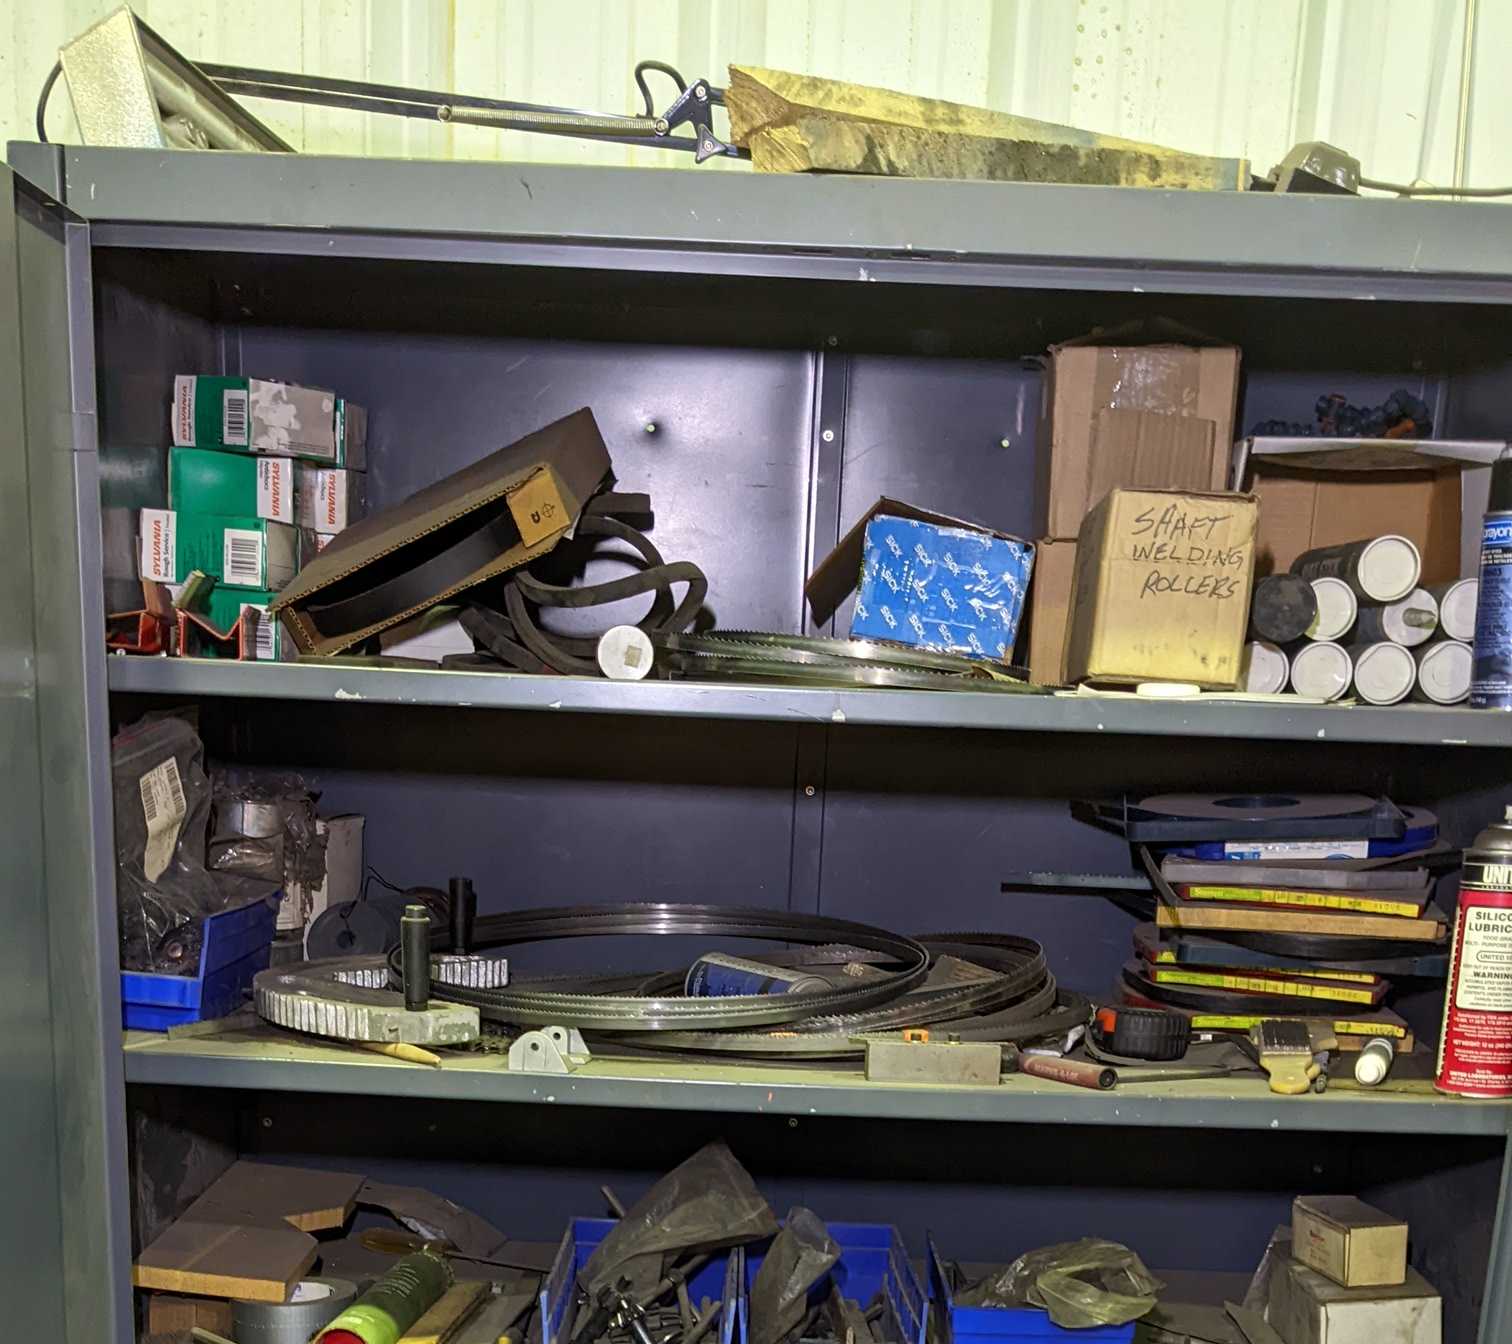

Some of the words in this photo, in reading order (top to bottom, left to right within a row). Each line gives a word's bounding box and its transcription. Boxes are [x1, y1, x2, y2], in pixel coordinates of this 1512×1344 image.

[271, 461, 281, 517] SYLVANIA
[327, 473, 337, 525] SYLVANIA
[1131, 503, 1234, 540] SHAFT
[152, 520, 162, 576] SYLVANIA
[885, 534, 903, 558] SICK
[914, 544, 932, 568] SICK
[1132, 541, 1243, 570] WELDING
[943, 552, 961, 576] SICK
[882, 569, 900, 594] SICK
[1140, 570, 1240, 599] ROLLERS
[941, 588, 958, 612] SICK
[880, 605, 898, 629] SICK
[909, 614, 926, 639] SICK
